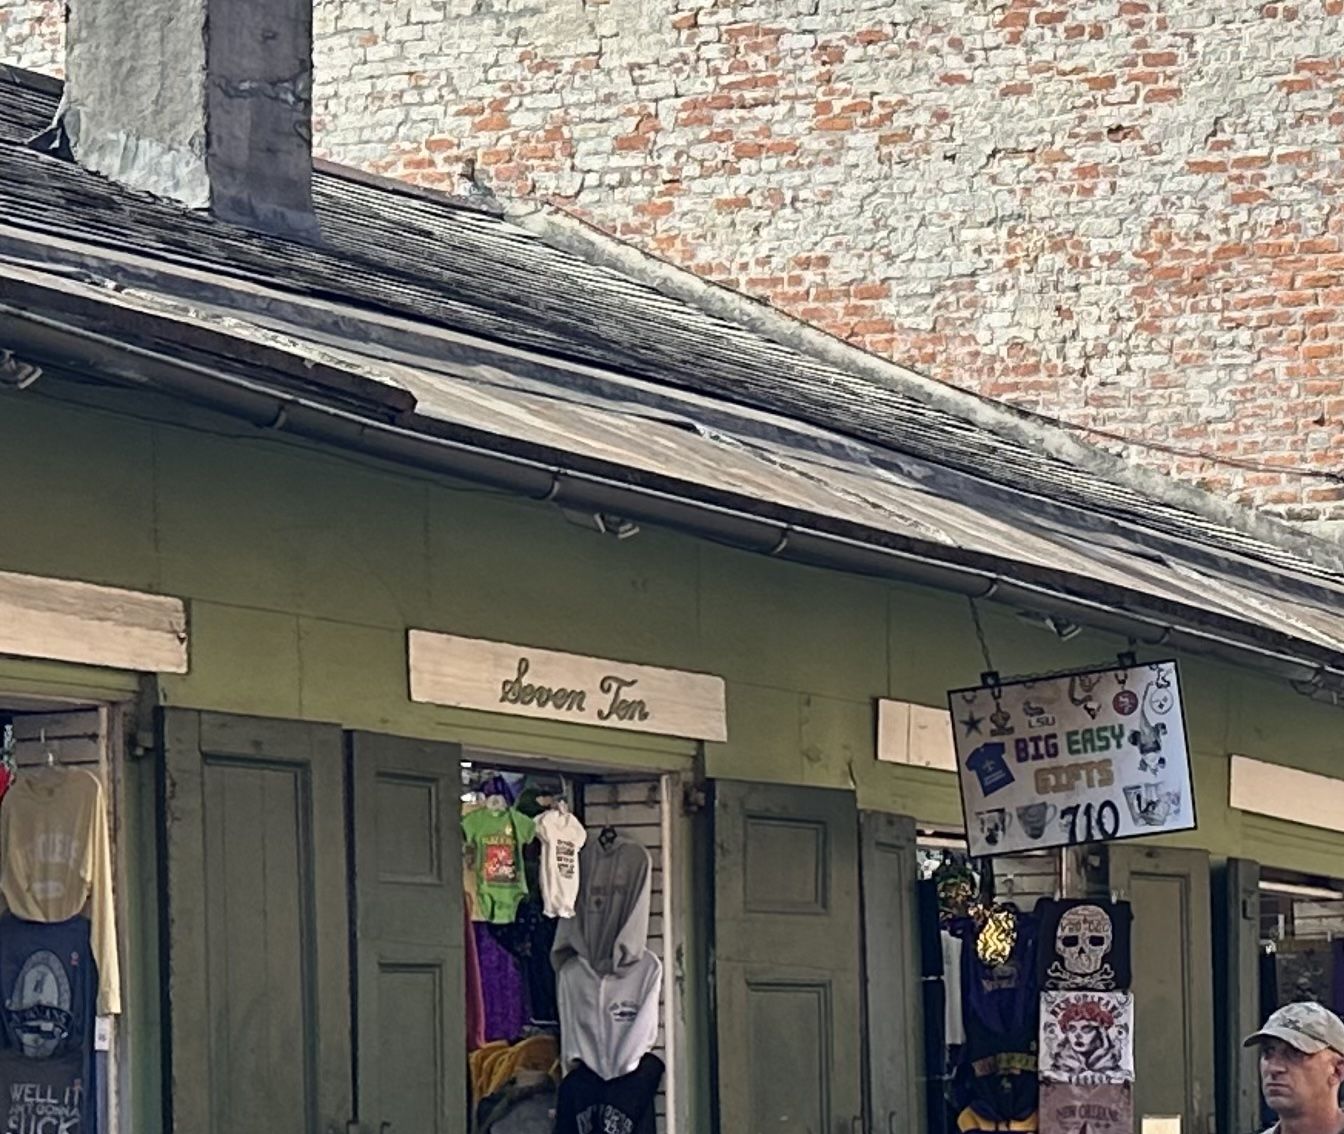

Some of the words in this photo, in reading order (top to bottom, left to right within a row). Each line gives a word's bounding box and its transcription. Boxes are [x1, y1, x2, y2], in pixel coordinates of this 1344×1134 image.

[500, 657, 586, 712] Seven
[597, 675, 650, 721] Ten
[1014, 733, 1059, 763] BIG
[1065, 723, 1126, 756] EASY
[1034, 758, 1115, 795] GIFTS
[1060, 799, 1120, 844] 710
[10, 1083, 59, 1104] WELL
